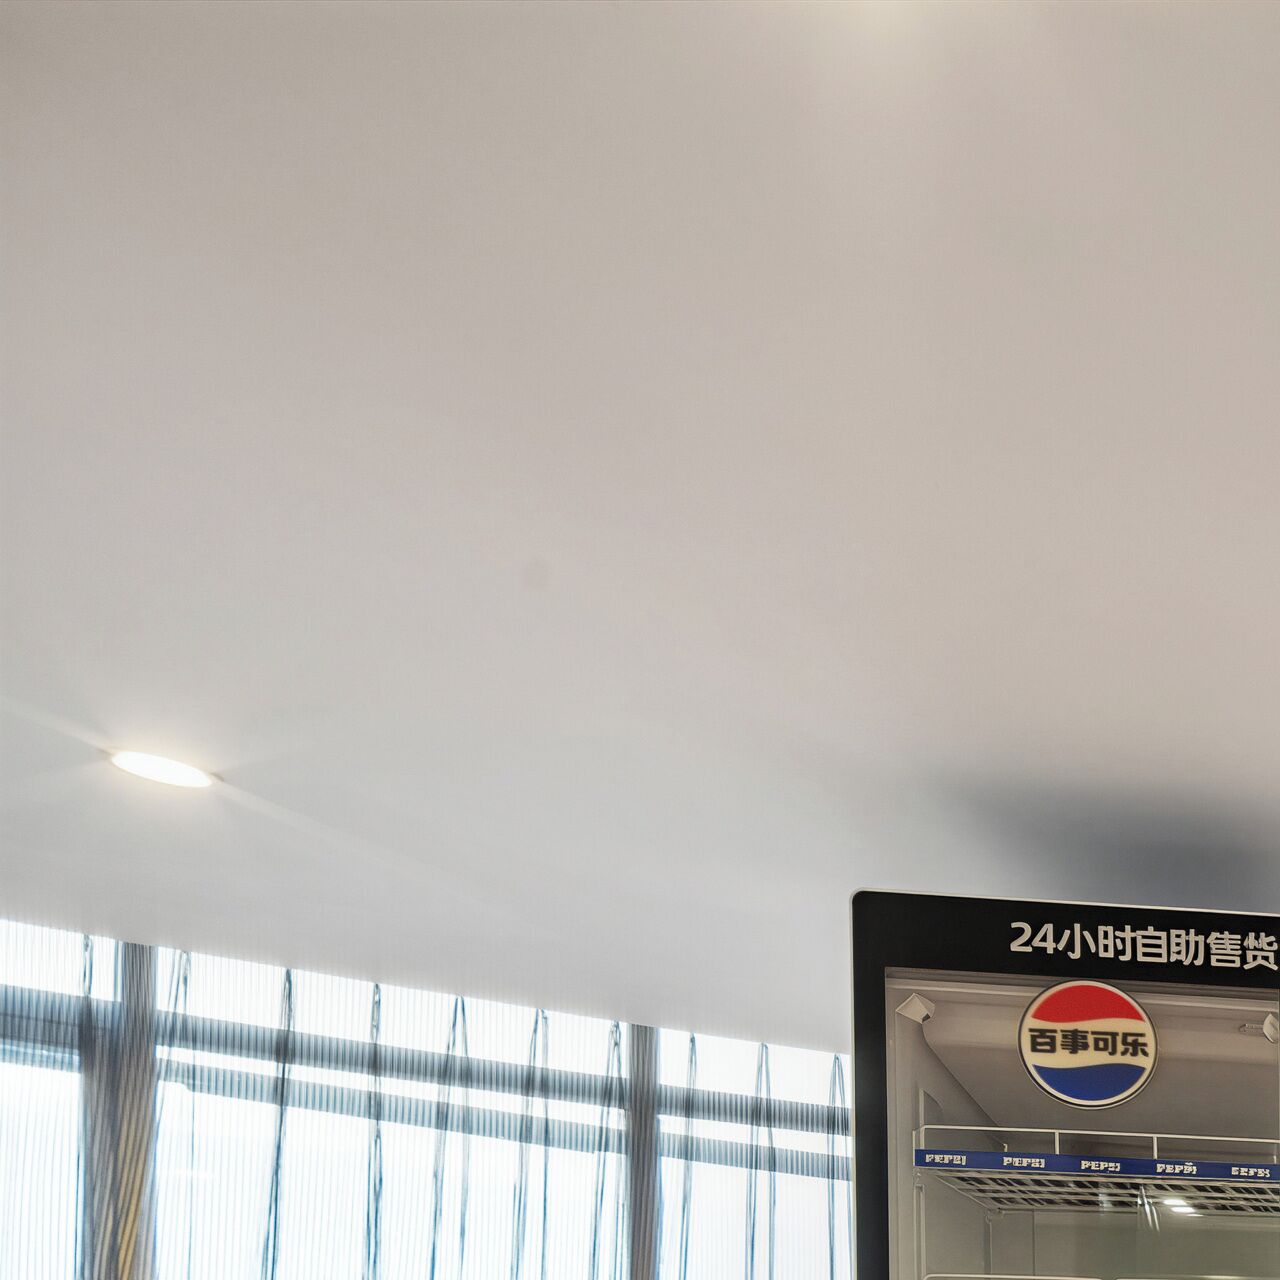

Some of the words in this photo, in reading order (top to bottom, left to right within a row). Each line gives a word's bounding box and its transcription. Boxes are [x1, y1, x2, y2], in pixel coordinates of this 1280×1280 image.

[1009, 921, 1279, 971] 24小时自助售货
[1028, 1027, 1150, 1058] 百事可乐
[1081, 1160, 1120, 1171] PEPSI
